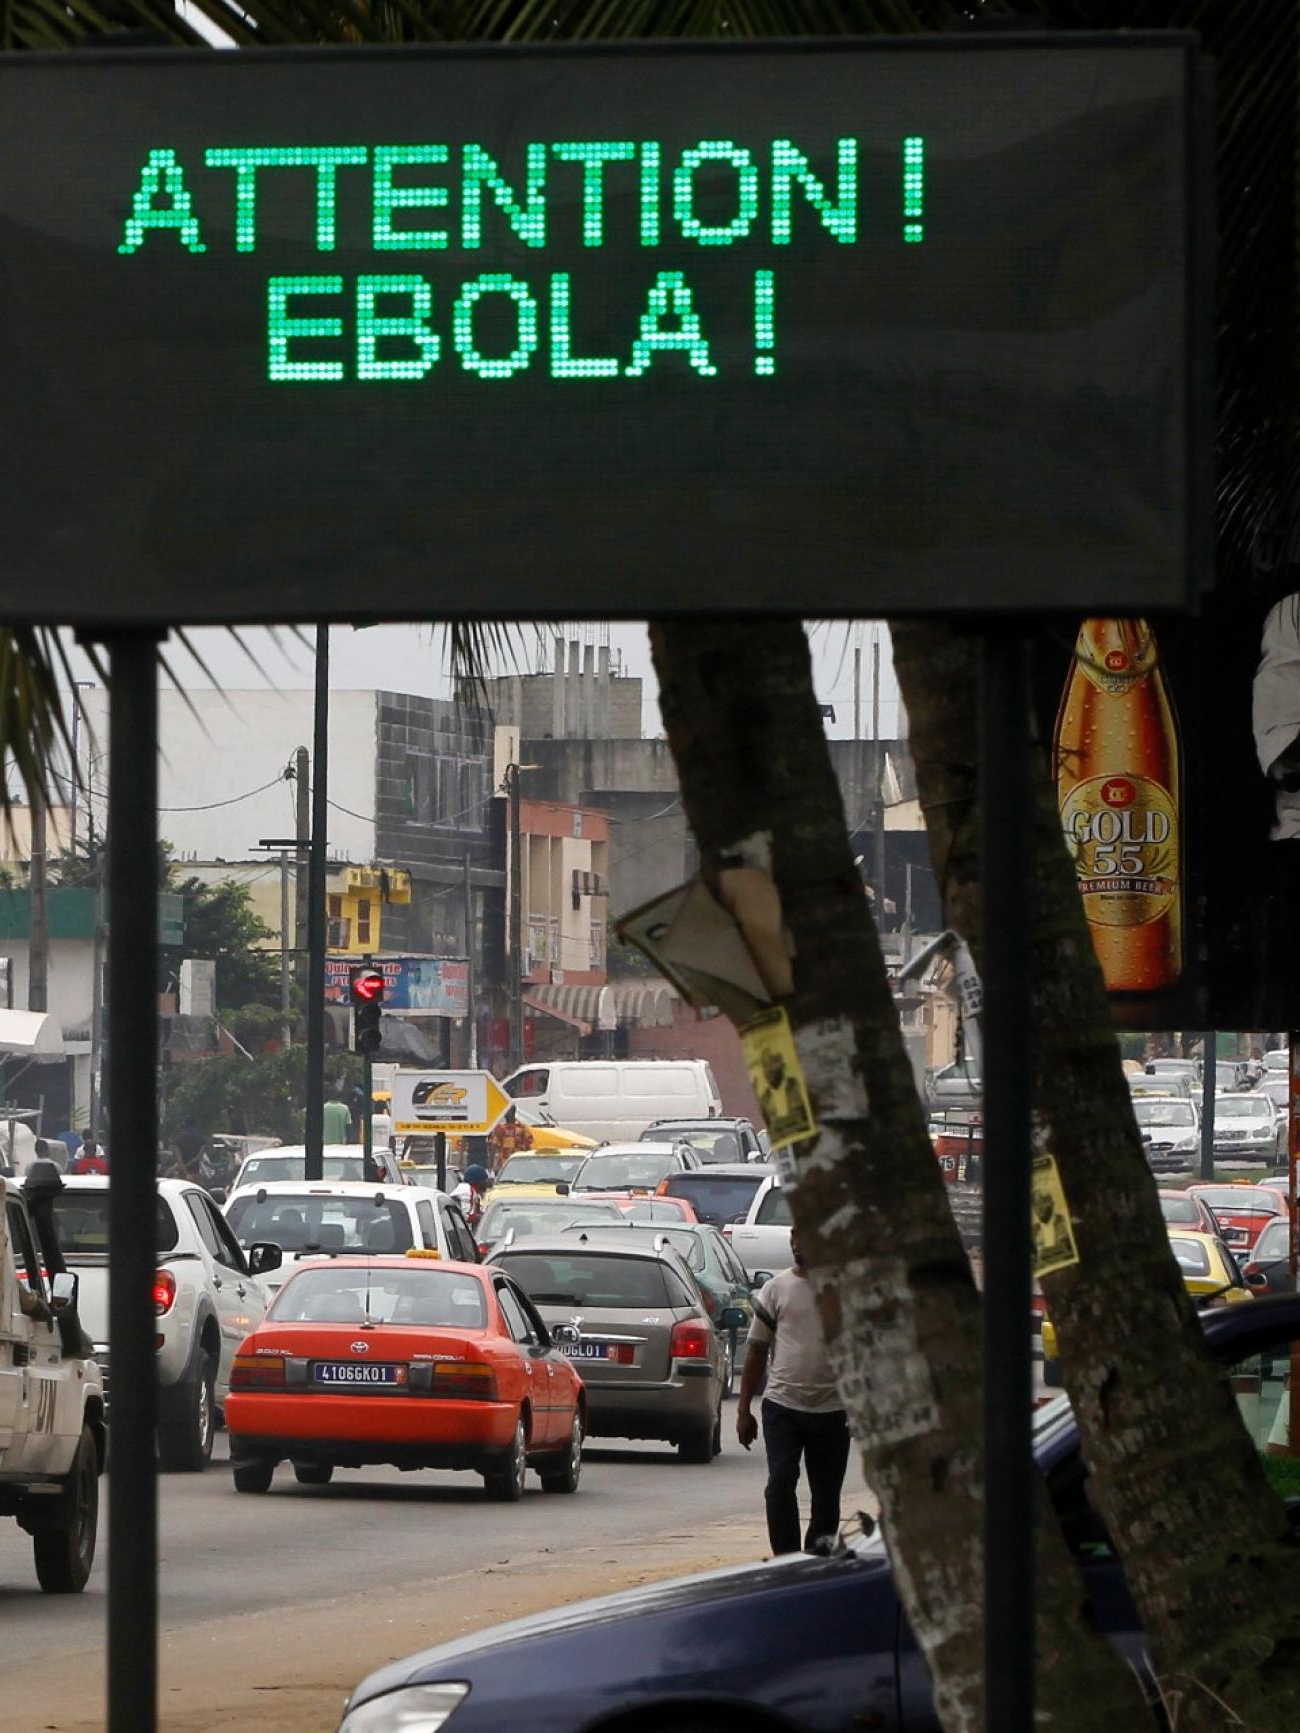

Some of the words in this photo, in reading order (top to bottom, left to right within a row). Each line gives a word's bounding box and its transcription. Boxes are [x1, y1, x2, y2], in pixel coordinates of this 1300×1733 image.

[117, 138, 857, 255] ATTENTION
[904, 136, 924, 243] !
[267, 270, 718, 380] EBOLA
[754, 269, 775, 375] !
[1067, 810, 1169, 844] GOLD
[322, 1366, 386, 1380] 4106GK01
